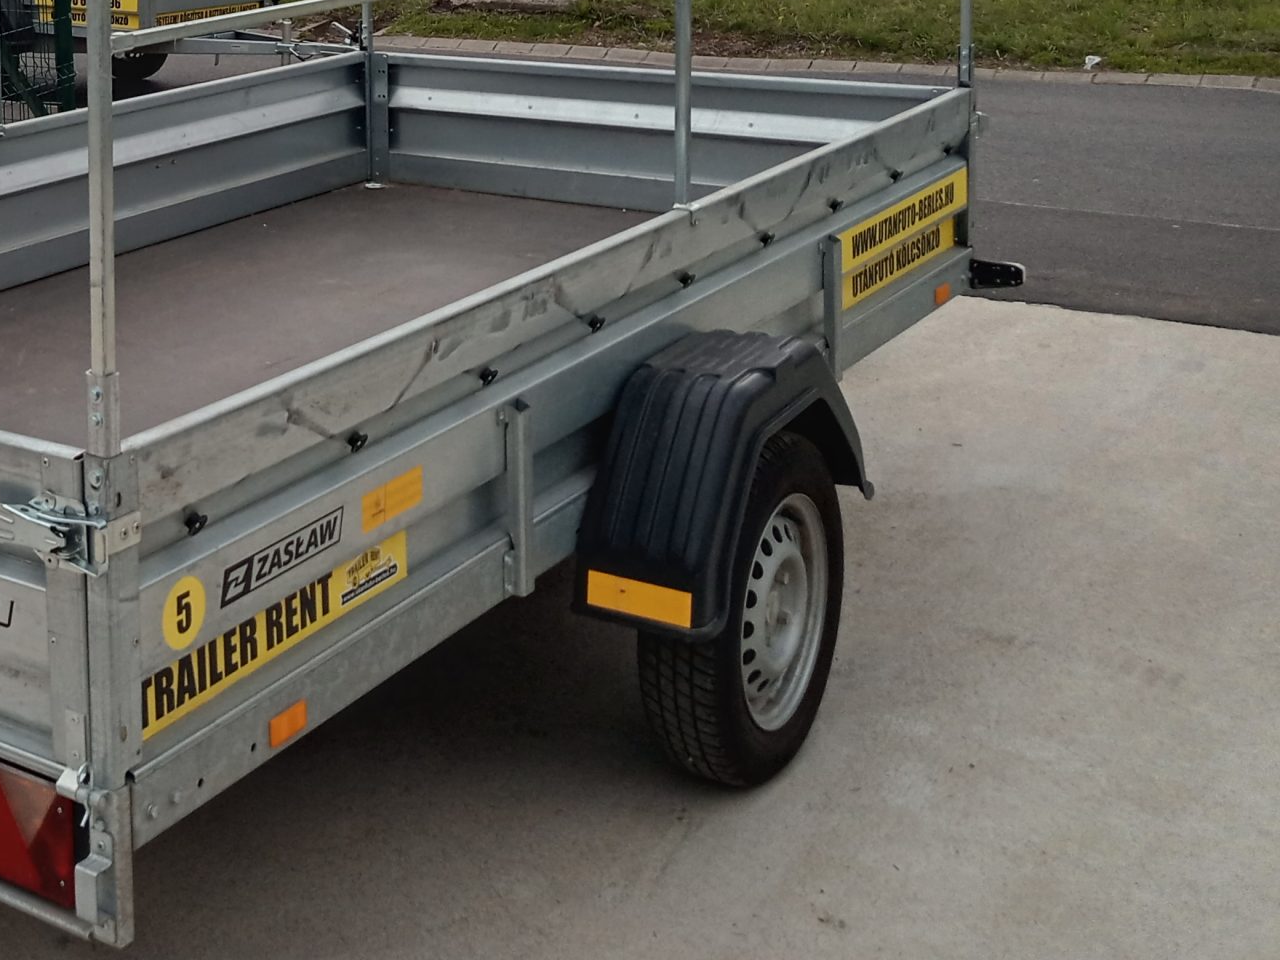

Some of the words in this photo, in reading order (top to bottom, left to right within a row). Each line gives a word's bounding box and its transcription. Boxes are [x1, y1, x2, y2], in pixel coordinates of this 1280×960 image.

[852, 182, 955, 259] WWW.UTANFUTO-BERLES.HU
[852, 254, 894, 297] UTÁNFUTÓ
[255, 514, 338, 582] ZASŁAW
[176, 590, 192, 634] 5
[264, 571, 333, 651] RENT
